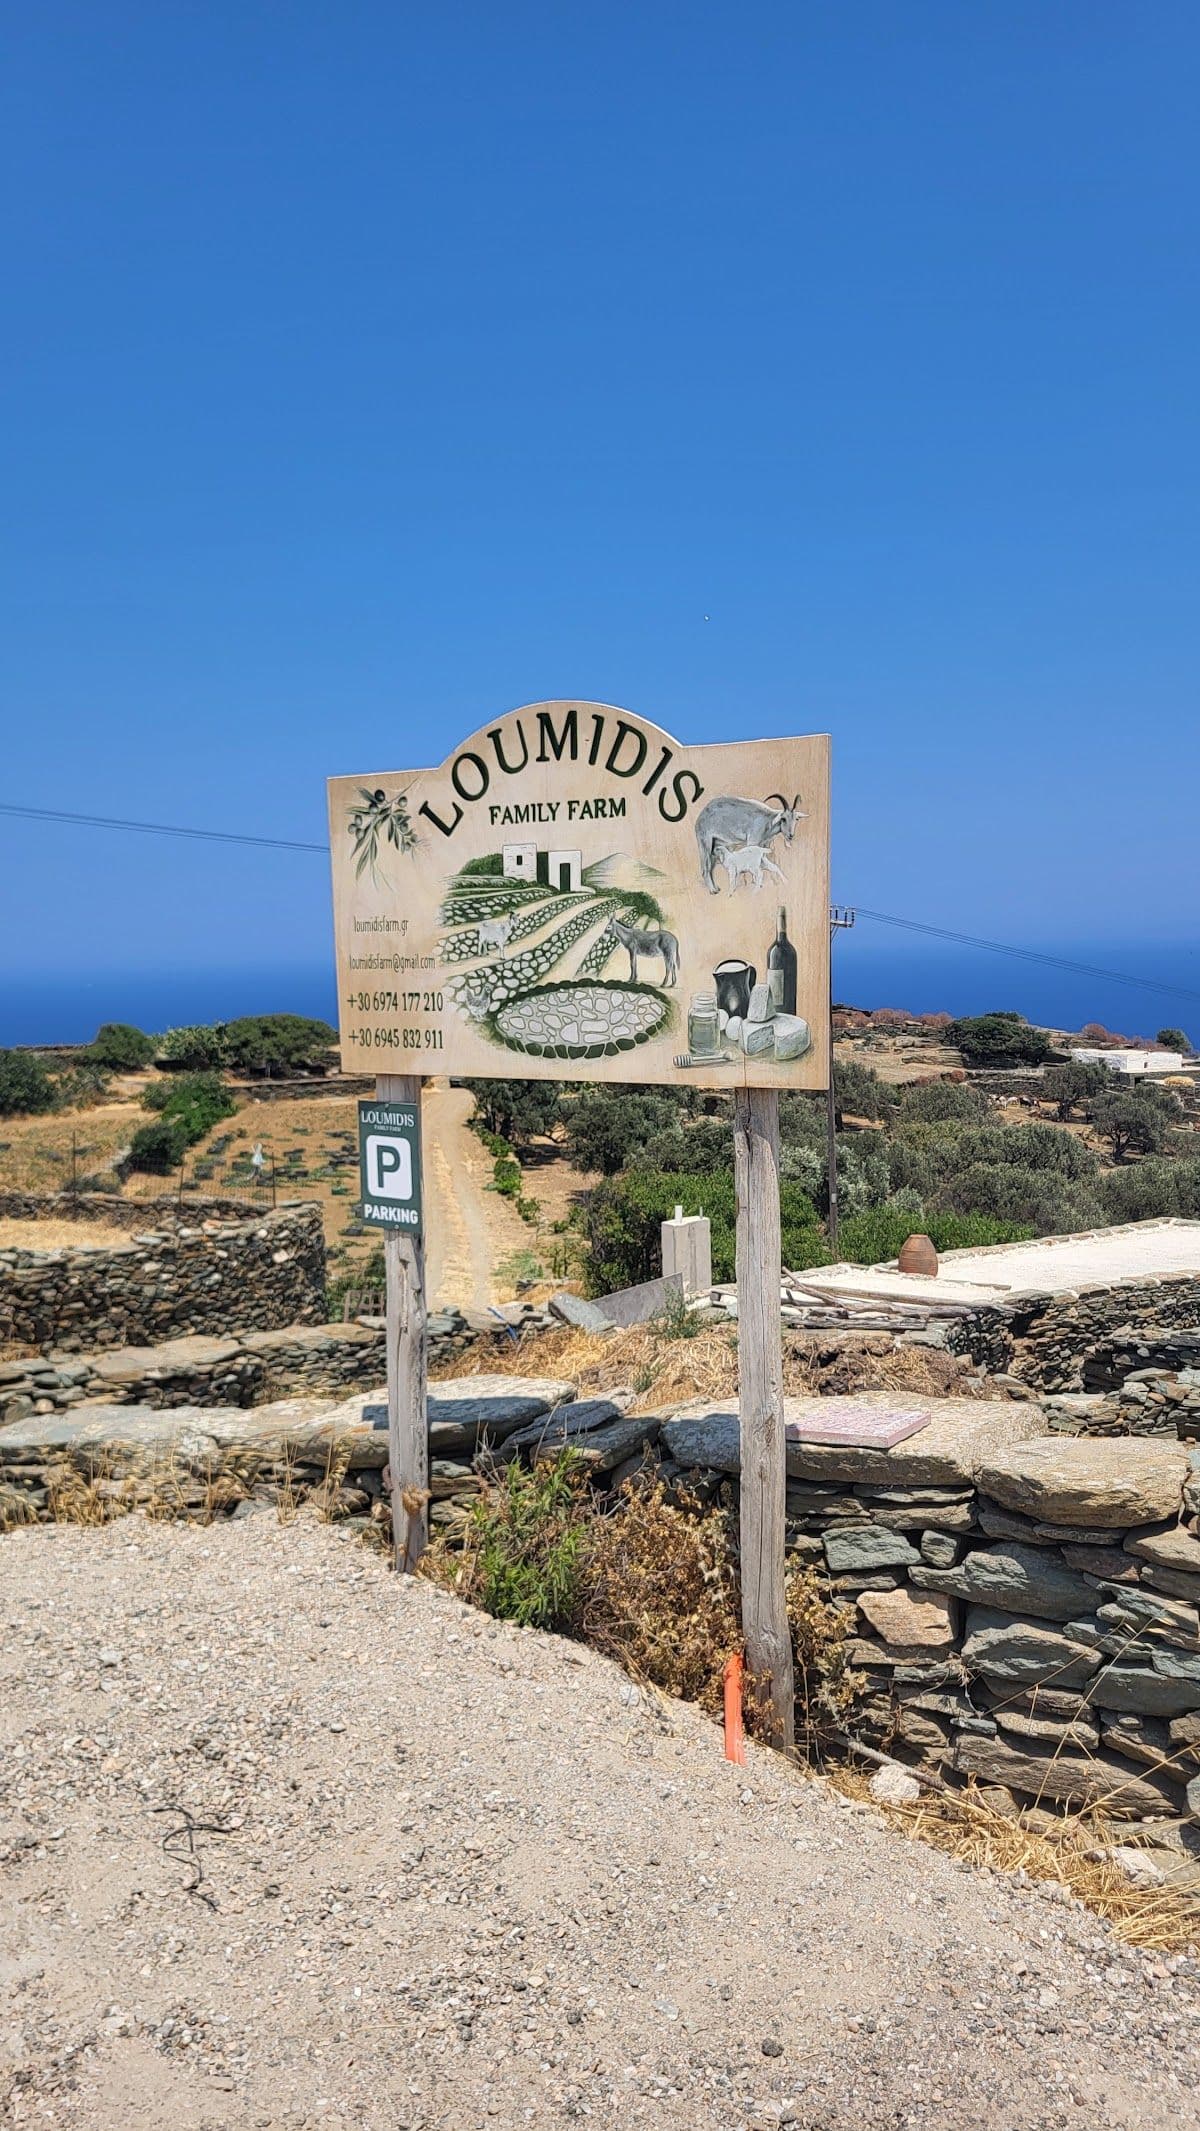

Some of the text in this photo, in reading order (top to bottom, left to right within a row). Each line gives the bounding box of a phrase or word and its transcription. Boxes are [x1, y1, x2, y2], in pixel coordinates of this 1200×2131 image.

[419, 711, 704, 837] LOUMIDIS
[489, 798, 626, 825] FAMILY FARM
[349, 953, 435, 973] loumidisfarm@gmail.com
[347, 992, 443, 1011] +30 6974 177 210
[348, 1028, 443, 1049] +30 6945 832 911
[361, 1111, 414, 1127] LOUMIDIS
[376, 1144, 400, 1188] P
[364, 1204, 418, 1224] PARKING
